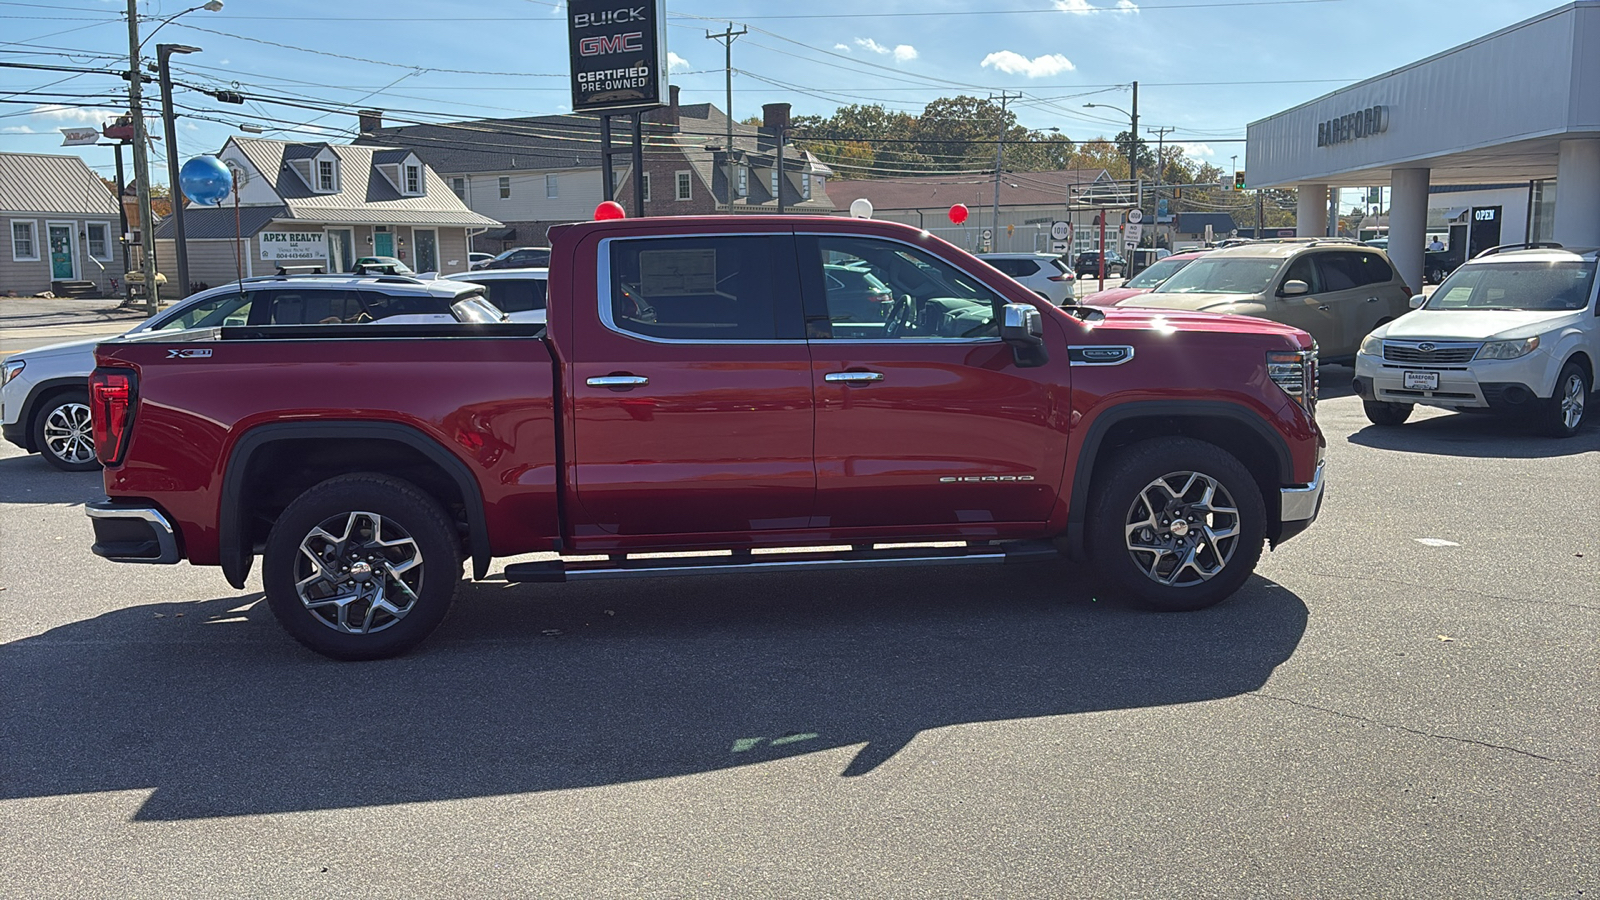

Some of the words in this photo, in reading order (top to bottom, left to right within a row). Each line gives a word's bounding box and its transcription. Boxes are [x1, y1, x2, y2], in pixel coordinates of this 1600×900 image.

[574, 6, 646, 28] BUICK
[580, 31, 643, 56] GMC
[577, 66, 648, 82] CERTIFIED
[581, 78, 646, 92] PRE-OWNED
[1317, 105, 1388, 148] BAREFORD
[1475, 209, 1495, 221] OPEN
[263, 233, 287, 242] APEX
[289, 233, 323, 242] REALTY
[1053, 226, 1068, 235] 1010
[939, 475, 1035, 483] SIERRA
